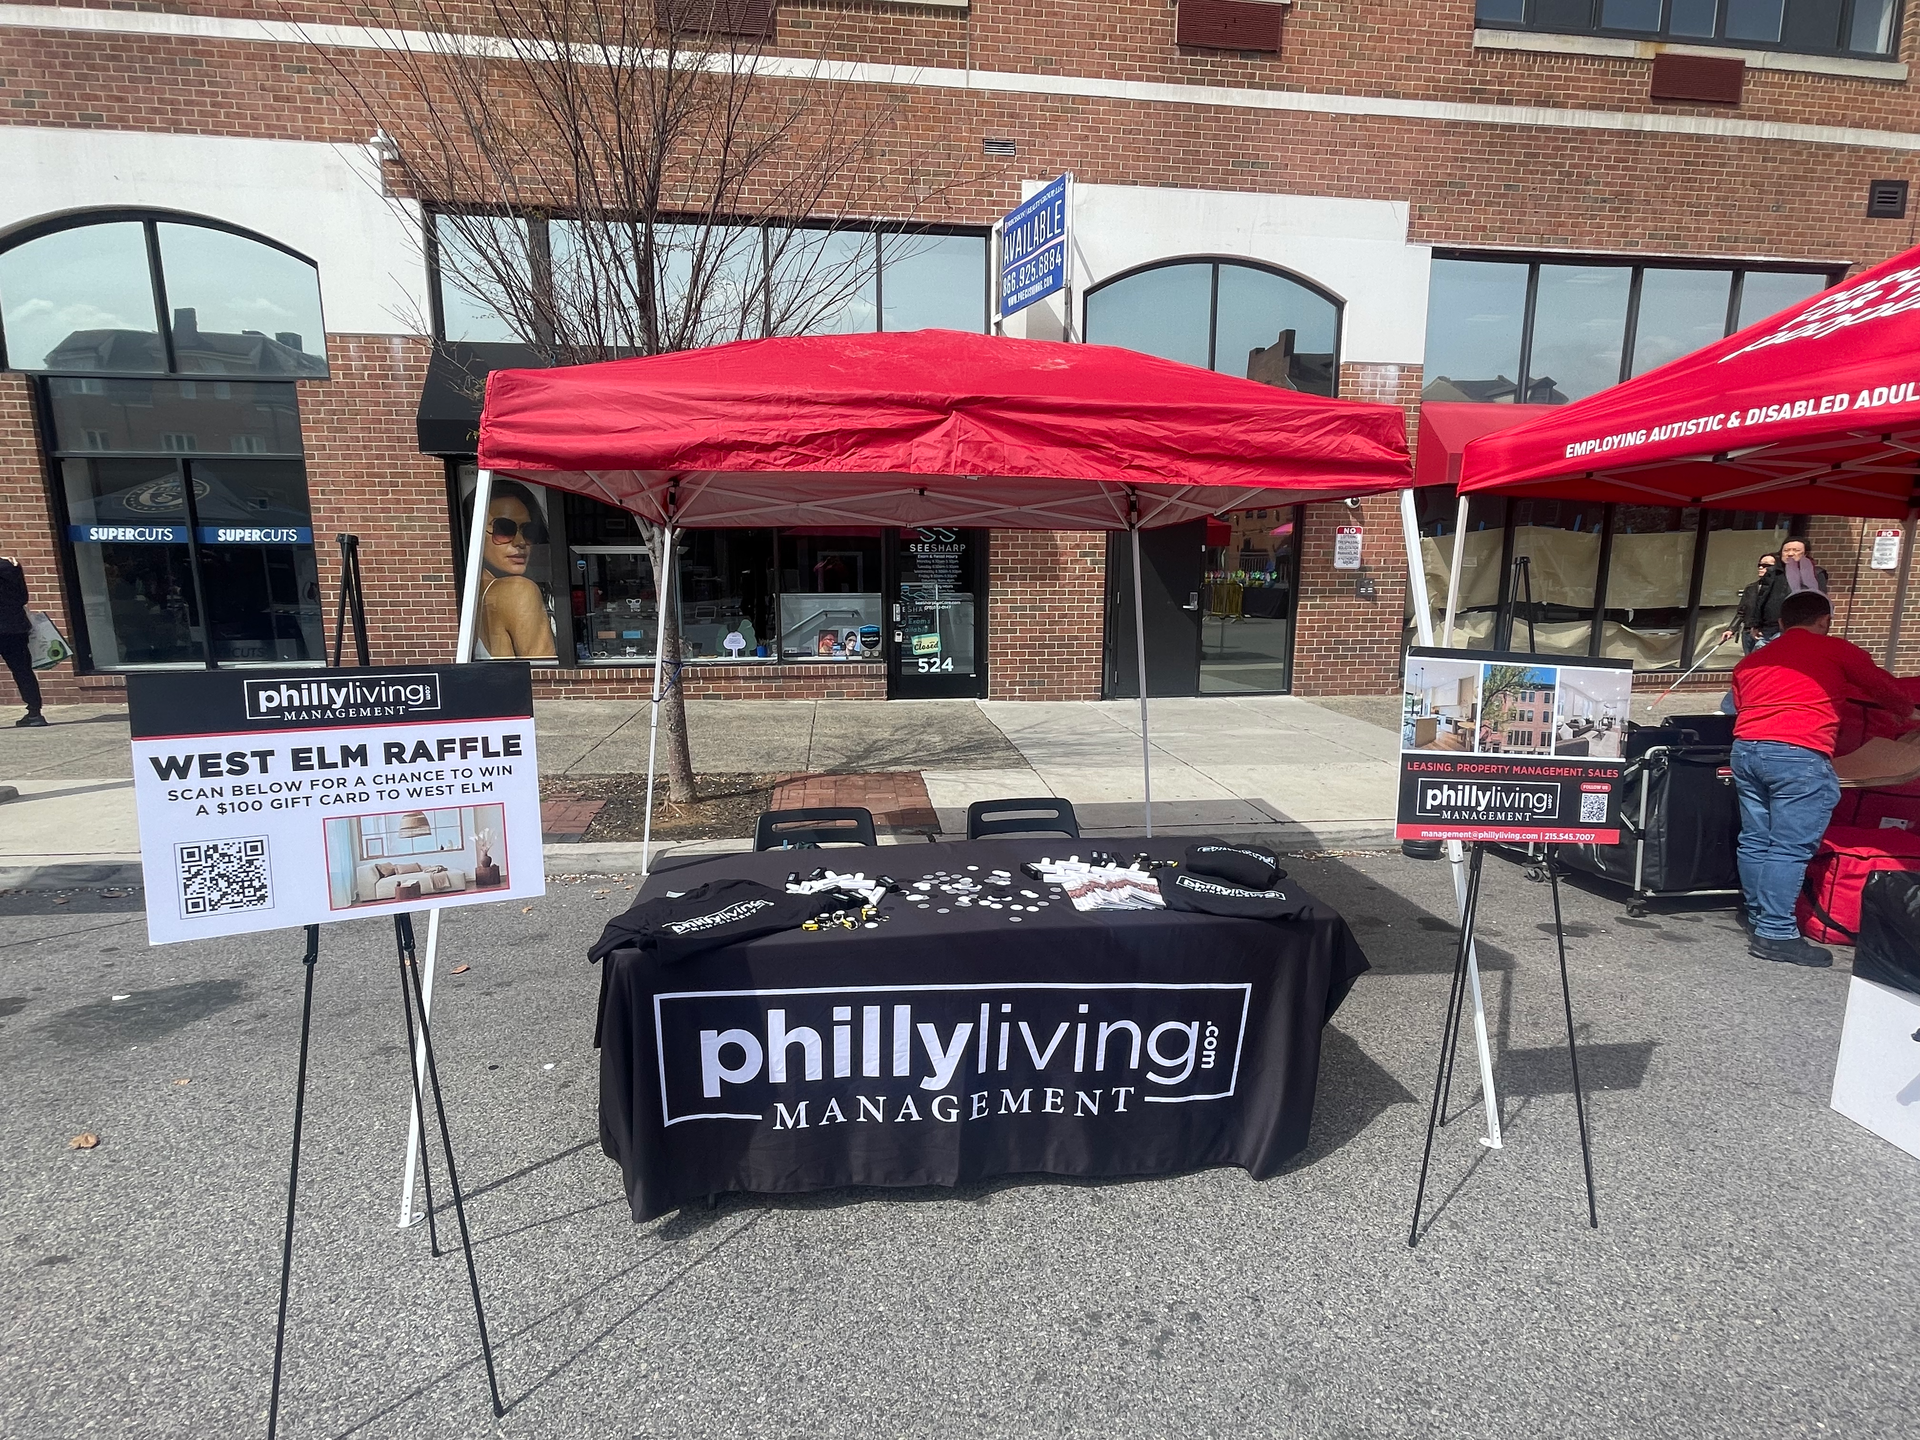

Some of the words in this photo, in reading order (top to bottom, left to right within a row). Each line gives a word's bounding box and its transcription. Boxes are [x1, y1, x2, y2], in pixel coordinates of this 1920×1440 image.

[1003, 199, 1062, 267] AVAILABLE
[1002, 245, 1062, 297] 866.925.6884
[1886, 279, 1920, 300] T
[1565, 429, 1647, 458] EMPLOYING
[1648, 411, 1724, 443] AUTISTIC
[1726, 411, 1741, 428] &
[1745, 393, 1850, 426] DISABLED
[1852, 381, 1920, 410] ADUL
[89, 527, 173, 541] SUPERCUTS
[217, 528, 298, 542] SUPERCUTS
[909, 543, 966, 552] SEESHARP
[914, 641, 939, 651] Closed
[917, 657, 954, 673] 524
[258, 680, 424, 713] phillyliving
[283, 705, 406, 721] MANAGEMENT
[149, 749, 275, 781] WEST
[290, 743, 369, 772] ELM
[383, 734, 523, 765] RAFFLE
[1407, 761, 1454, 773] LEASING.
[1456, 764, 1510, 775] PROPERTY
[1512, 766, 1586, 778] MANAGEMENT.
[1588, 768, 1619, 778] SALES
[167, 786, 224, 802] SCAN
[232, 780, 302, 797] BELOW
[310, 776, 348, 791] FOR
[353, 774, 367, 787] A
[372, 769, 445, 786] CHANCE
[449, 767, 473, 780] TO
[479, 764, 514, 778] WIN
[195, 803, 210, 816] A
[216, 800, 263, 816] $100
[270, 795, 313, 810] GIFT
[319, 790, 371, 806] CARD
[375, 788, 400, 801] TO
[407, 784, 454, 799] WEST
[461, 781, 494, 795] ELM
[1425, 784, 1548, 813] phillyliving
[1441, 810, 1533, 822] MANAGEMENT
[1421, 829, 1539, 841] management@phillyliving.com
[1544, 832, 1596, 841] 215.545.7007
[700, 1002, 1200, 1099] phillyliving
[772, 1086, 1136, 1131] MANAGEMENT
